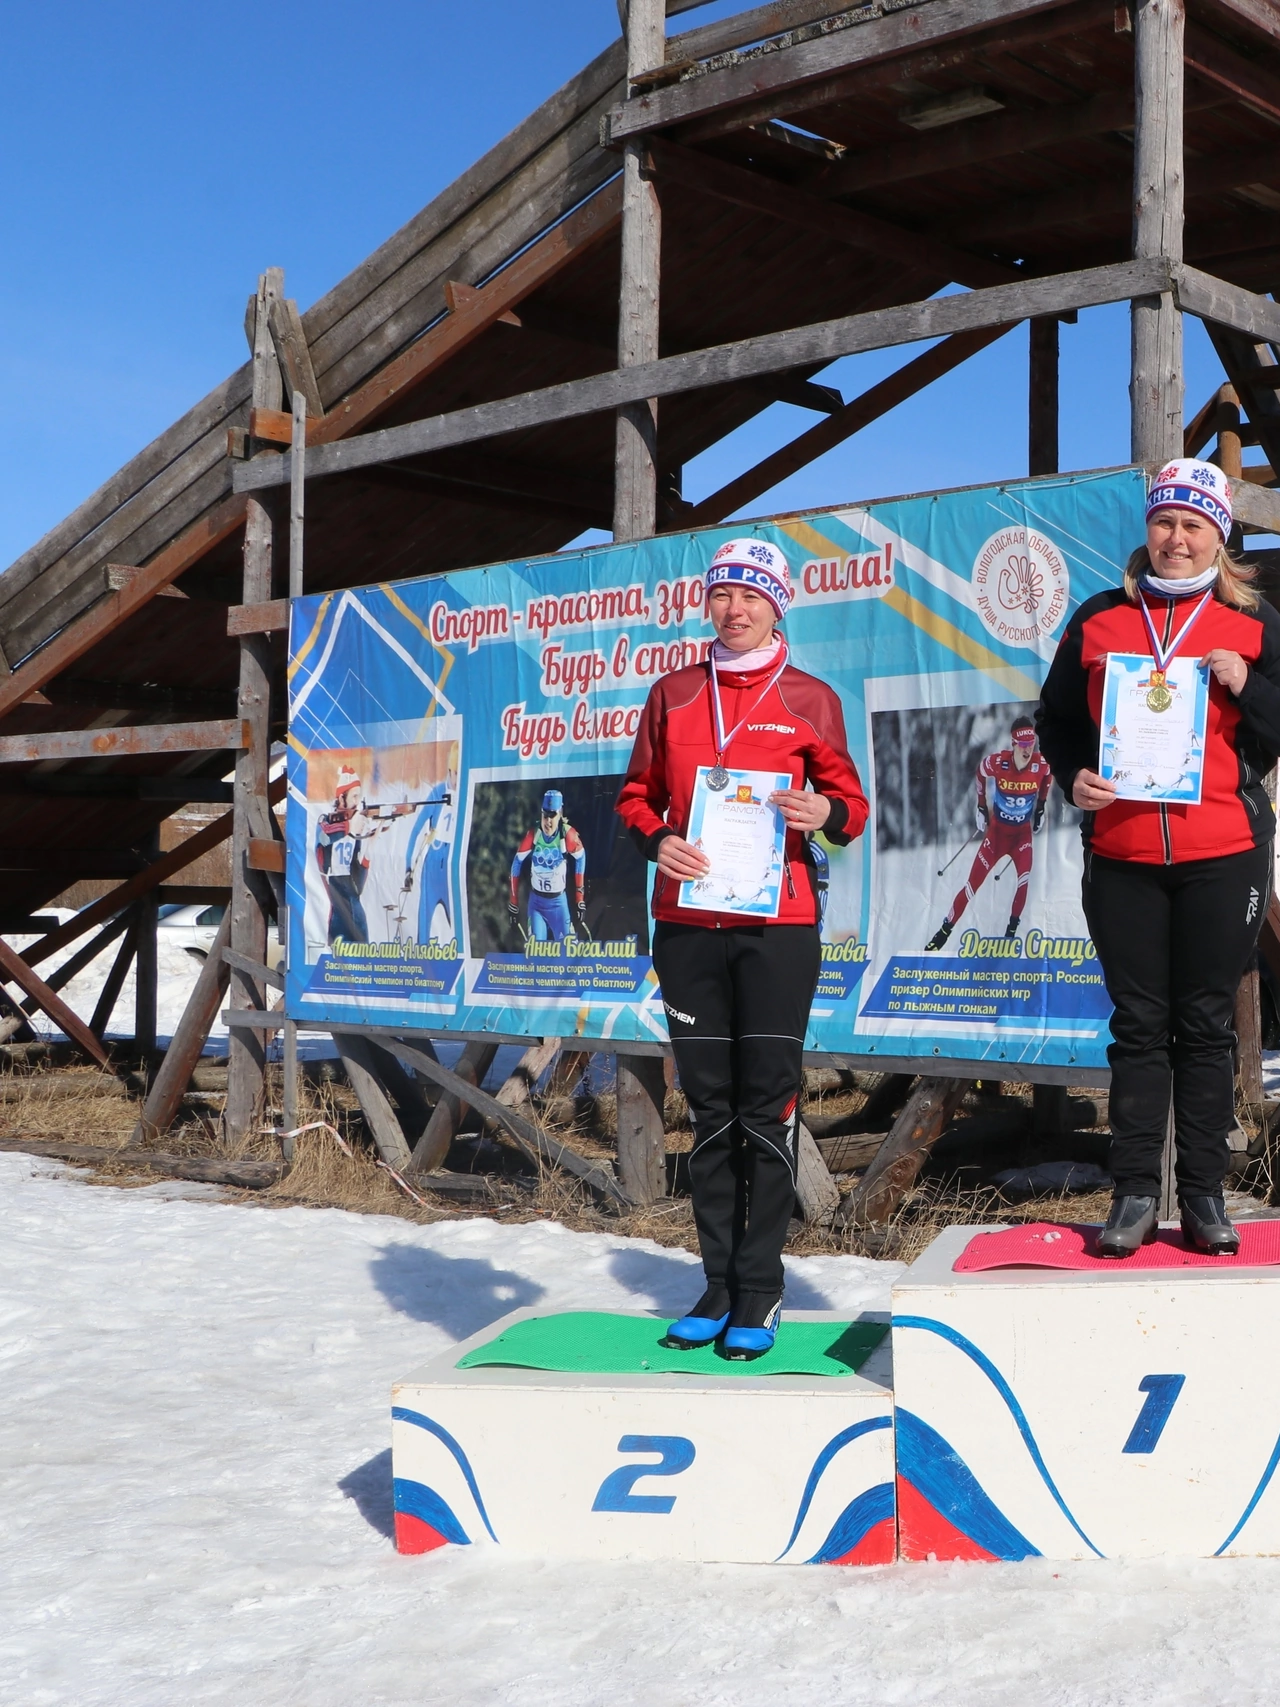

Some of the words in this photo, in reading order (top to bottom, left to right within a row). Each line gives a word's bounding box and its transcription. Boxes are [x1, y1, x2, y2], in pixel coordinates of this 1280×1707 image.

[977, 532, 1025, 584] ВОЛОГОДСКАЯ
[1028, 535, 1062, 576] ОБЛАСТЬ
[432, 604, 508, 649] Спорт
[528, 587, 650, 640] красота,
[803, 542, 892, 594] сила!
[977, 596, 998, 627] ДУША
[997, 622, 1042, 640] РУССКОГО
[1041, 587, 1065, 629] СЕВЕРА
[543, 646, 606, 696] Будь
[613, 637, 627, 678] в
[503, 708, 566, 757] Будь
[573, 702, 645, 741] вмес
[747, 723, 796, 735] VITZHEN
[1008, 782, 1038, 791] EXTRA
[716, 804, 766, 816] ГРАМОТА
[1006, 796, 1026, 808] 39
[334, 841, 353, 866] 13
[538, 879, 552, 892] 16
[331, 935, 401, 959] Анатолий
[402, 936, 458, 961] Алябьев
[524, 934, 561, 959] Анна
[563, 934, 637, 959] Богалий
[958, 930, 1021, 958] Денис
[1026, 930, 1098, 966] Спицо
[324, 960, 373, 973] Заслуженный
[374, 964, 398, 974] мастер
[399, 965, 424, 975] спорта,
[487, 960, 535, 974] Заслуженный
[536, 965, 565, 975] мастер
[596, 963, 633, 976] России,
[892, 966, 970, 982] Заслуженный
[973, 971, 1010, 983] мастер
[1013, 973, 1053, 985] спорта
[1056, 970, 1104, 987] России,
[324, 972, 372, 985] Олимпийский
[373, 977, 404, 986] чемпион
[414, 976, 445, 990] биатлону
[488, 974, 535, 986] Олимпийская
[536, 978, 577, 987] чемпионка
[579, 979, 591, 988] по
[592, 976, 637, 991] биатлону
[890, 984, 930, 997] призер
[932, 984, 1010, 998] Олимпийских
[1011, 988, 1031, 1001] игр
[888, 1002, 901, 1010] по
[903, 1002, 955, 1013] лыжным
[958, 1004, 997, 1015] гонкам
[1122, 1374, 1187, 1454] 1
[591, 1434, 697, 1514] 2
